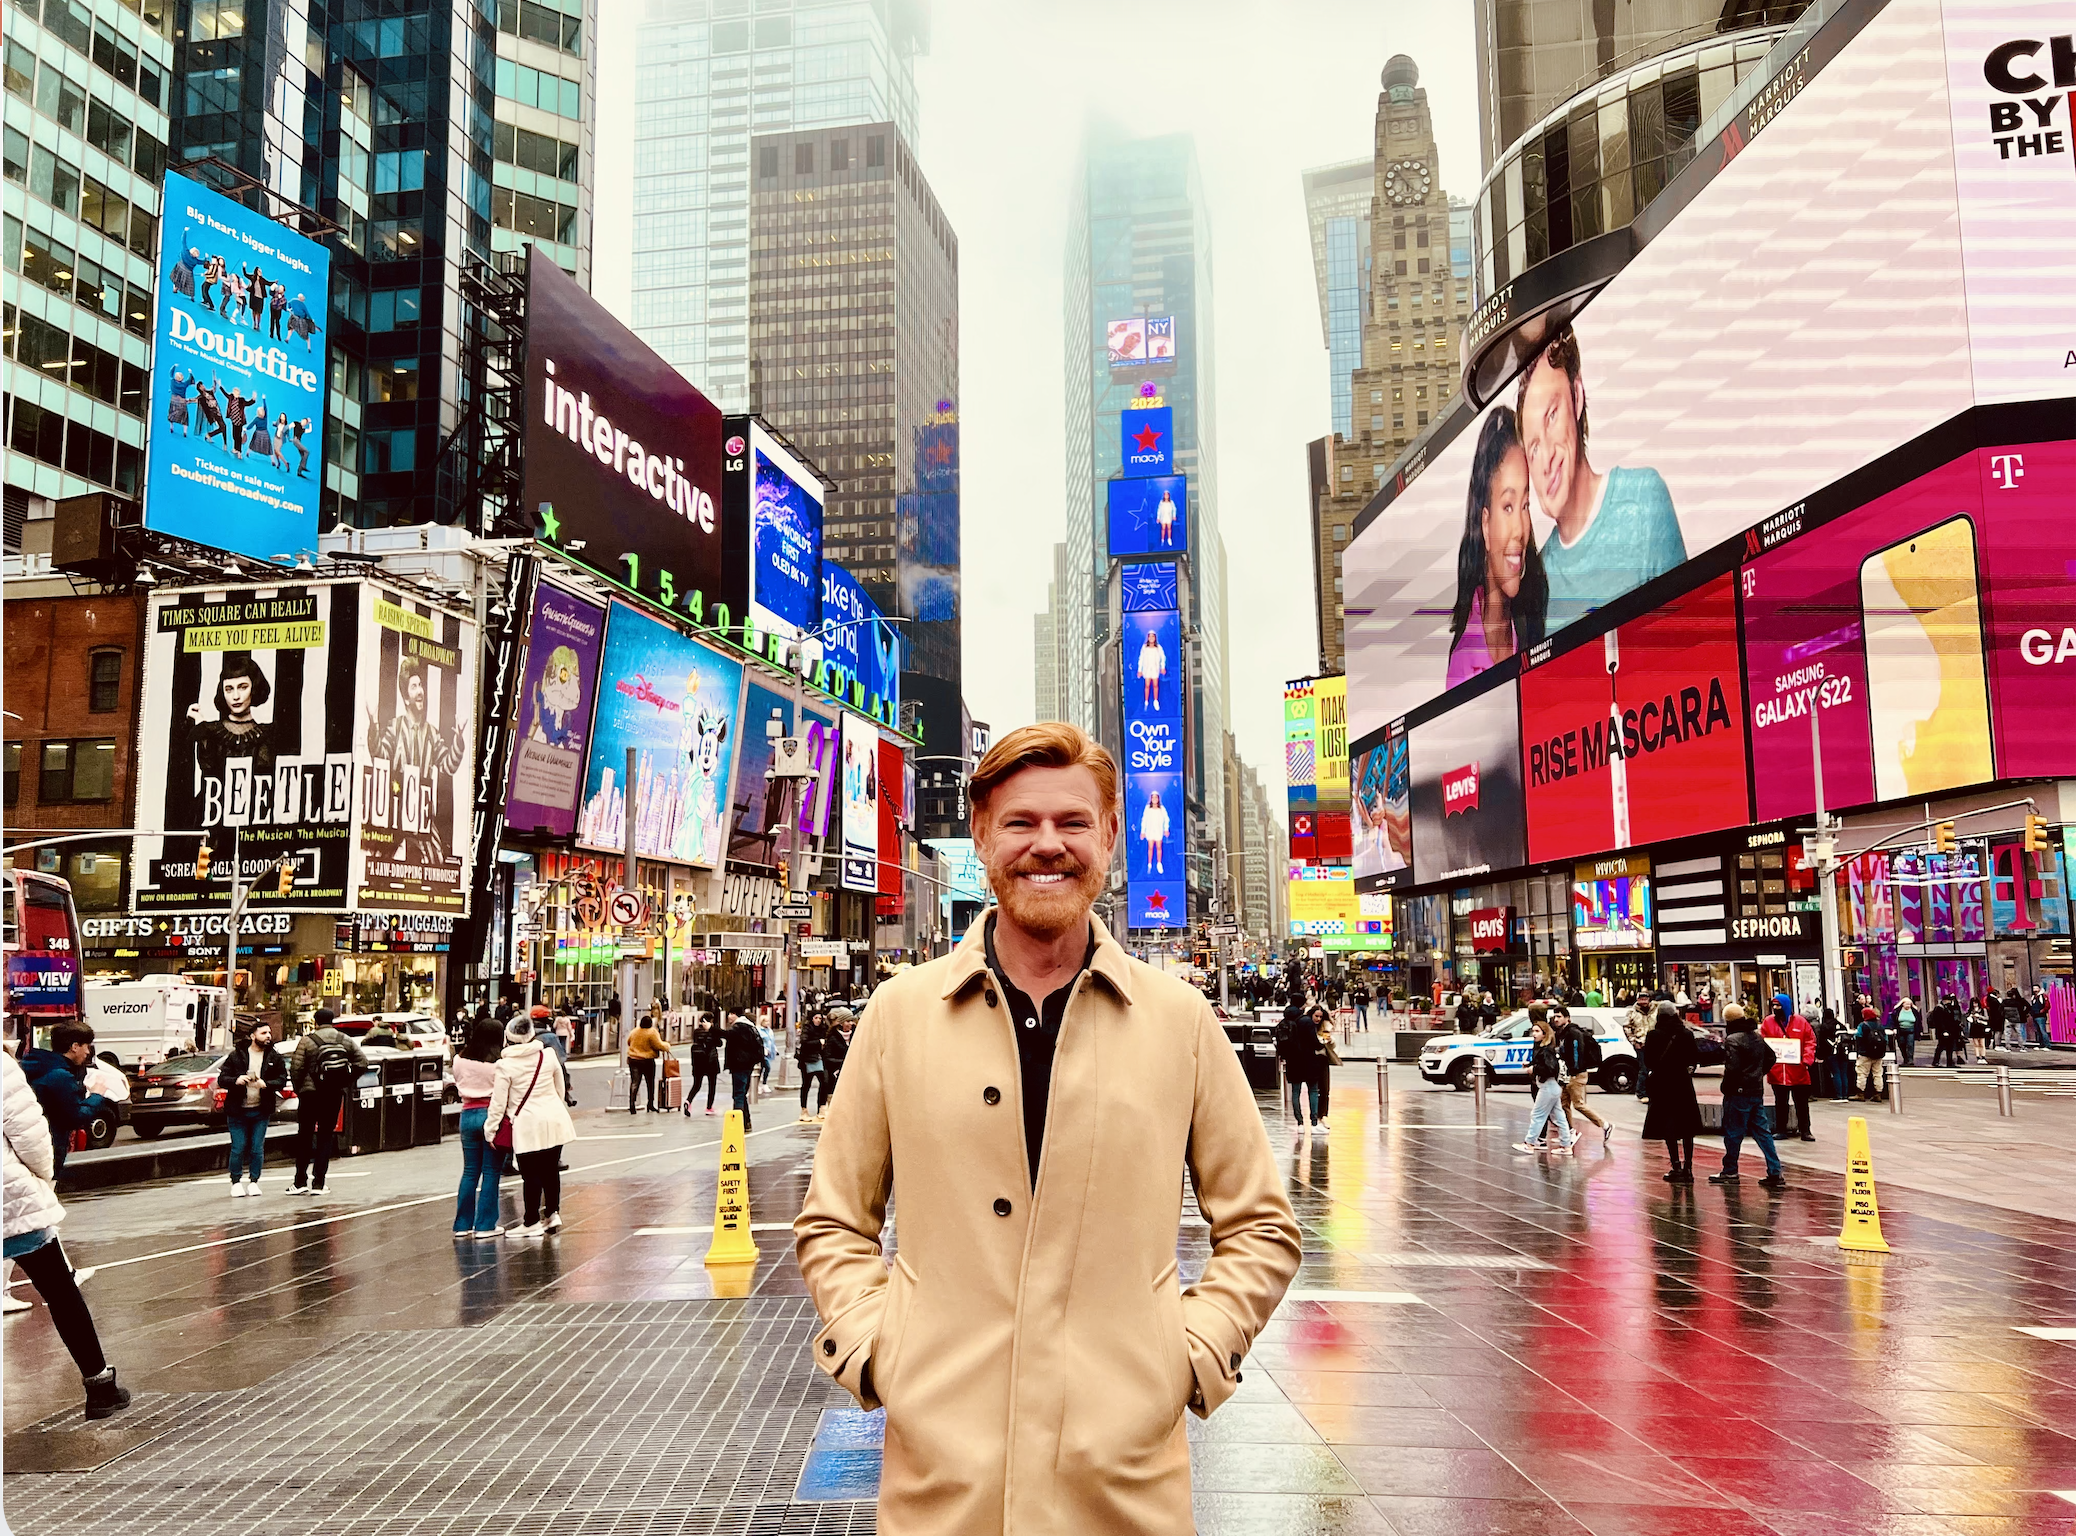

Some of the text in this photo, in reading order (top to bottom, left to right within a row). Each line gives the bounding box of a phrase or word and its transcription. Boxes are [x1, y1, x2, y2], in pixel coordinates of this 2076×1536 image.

[1748, 46, 1811, 120] MARRIOTT
[1749, 77, 1805, 139] MARQUIS
[1989, 95, 2063, 133] BY
[1993, 131, 2065, 160] THE
[186, 205, 312, 275] Big heart, bigger laughs.
[1468, 285, 1514, 334] MARRIOTT
[1148, 322, 1169, 336] NY
[1469, 307, 1508, 350] MARQUIS
[169, 307, 317, 392] Doubtfire
[169, 338, 253, 379] The New Musical Comedy
[1130, 397, 1164, 410] 2022
[543, 358, 715, 534] interactive
[1130, 451, 1164, 465] macy's
[726, 459, 744, 472] LG
[1404, 447, 1427, 475] MARRIOTT
[1405, 461, 1425, 485] MARQUIS
[195, 457, 285, 496] Tickets on sale now!
[171, 463, 304, 515] DoubtfireBroadway.com
[1763, 503, 1805, 534] MARRIOTT
[770, 514, 812, 554] THE WORLD'S
[1763, 520, 1802, 547] MARQUIS
[782, 541, 800, 563] FIRST
[772, 552, 809, 588] OLED 8K TV
[162, 598, 313, 627] TIMES SQUARE CAN REALLY
[850, 589, 864, 627] the
[378, 604, 431, 638] RAISING SPIRITS
[189, 626, 321, 647] MAKE YOU FEEL ALIVE!
[408, 637, 456, 667] ON BROADWAY!
[1775, 662, 1824, 693] SAMSUNG
[1321, 695, 1346, 727] MAK
[1755, 676, 1852, 728] GALAXY S22
[1129, 720, 1169, 738] Own
[1530, 677, 1732, 787] RISE MASCARA
[1141, 736, 1176, 752] Your
[1322, 727, 1347, 759] LOST
[1132, 751, 1172, 771] Style
[201, 753, 352, 827] BEETLE
[957, 786, 966, 821] 1500
[239, 830, 255, 842] The
[297, 828, 313, 840] The
[1748, 831, 1785, 848] SEPHORA
[242, 859, 271, 874] GOOD
[375, 863, 422, 880] JAW-DROPPING
[1595, 858, 1628, 877] INVICTA
[141, 893, 154, 902] NOW
[156, 893, 165, 901] ON
[166, 892, 198, 901] BROADWAY
[311, 889, 343, 897] BROADWAY
[82, 914, 291, 938] GIFTS LUGGAGE
[398, 914, 454, 933] LUGGAGE
[1145, 909, 1170, 920] macy's
[1732, 916, 1802, 939] SEPHORA
[49, 938, 70, 950] 348
[91, 950, 107, 958] Apple
[114, 949, 139, 957] Nikon
[187, 947, 221, 956] SONY
[182, 935, 204, 946] NY
[414, 943, 433, 951] SONY
[1365, 938, 1387, 946] NEW
[737, 950, 764, 966] FOREVER
[12, 972, 73, 986] TOPVIEW
[103, 1001, 148, 1014] verizon
[1505, 1049, 1533, 1062] NYP
